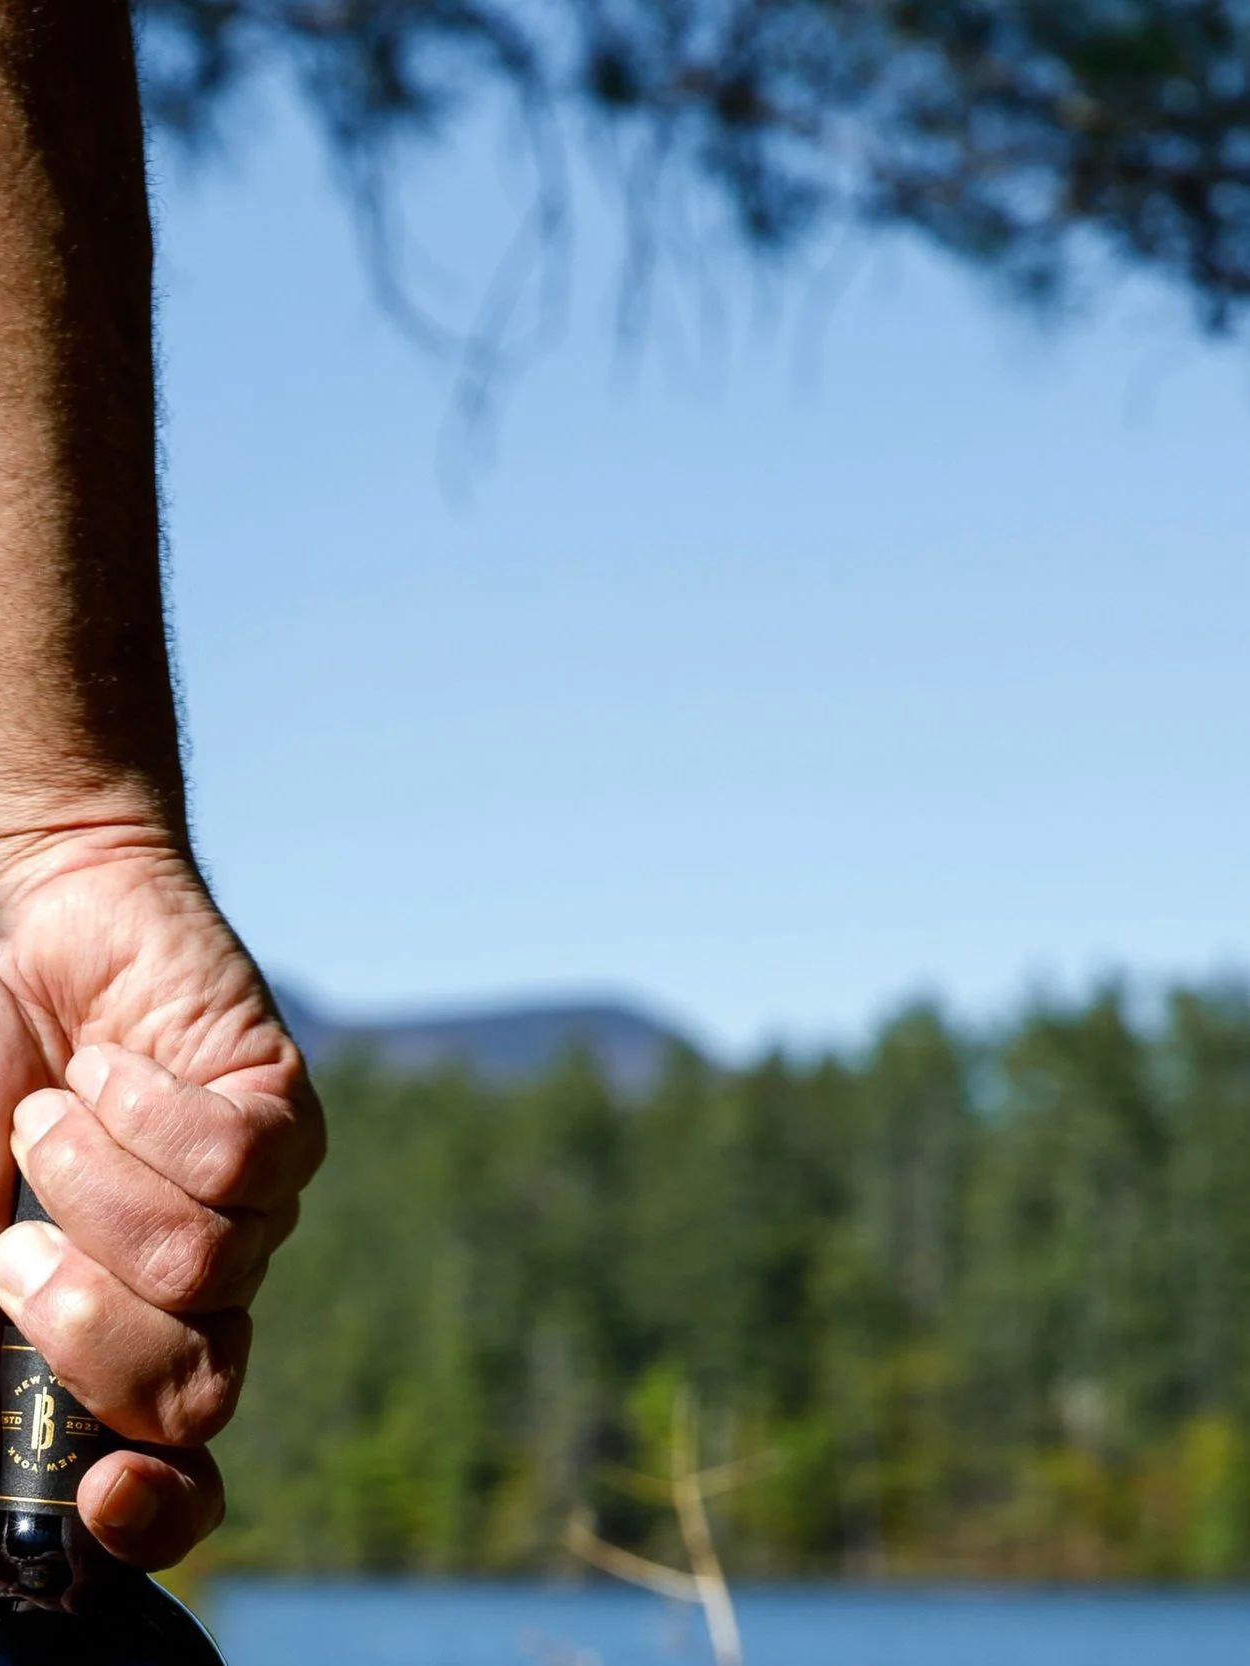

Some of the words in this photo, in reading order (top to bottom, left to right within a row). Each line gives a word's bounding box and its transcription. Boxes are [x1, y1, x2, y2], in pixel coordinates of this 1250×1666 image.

[14, 1375, 41, 1396] NEW
[2, 1416, 23, 1426] STD
[31, 1386, 55, 1462] B
[8, 1446, 38, 1473] YORK
[46, 1452, 77, 1472] NEW
